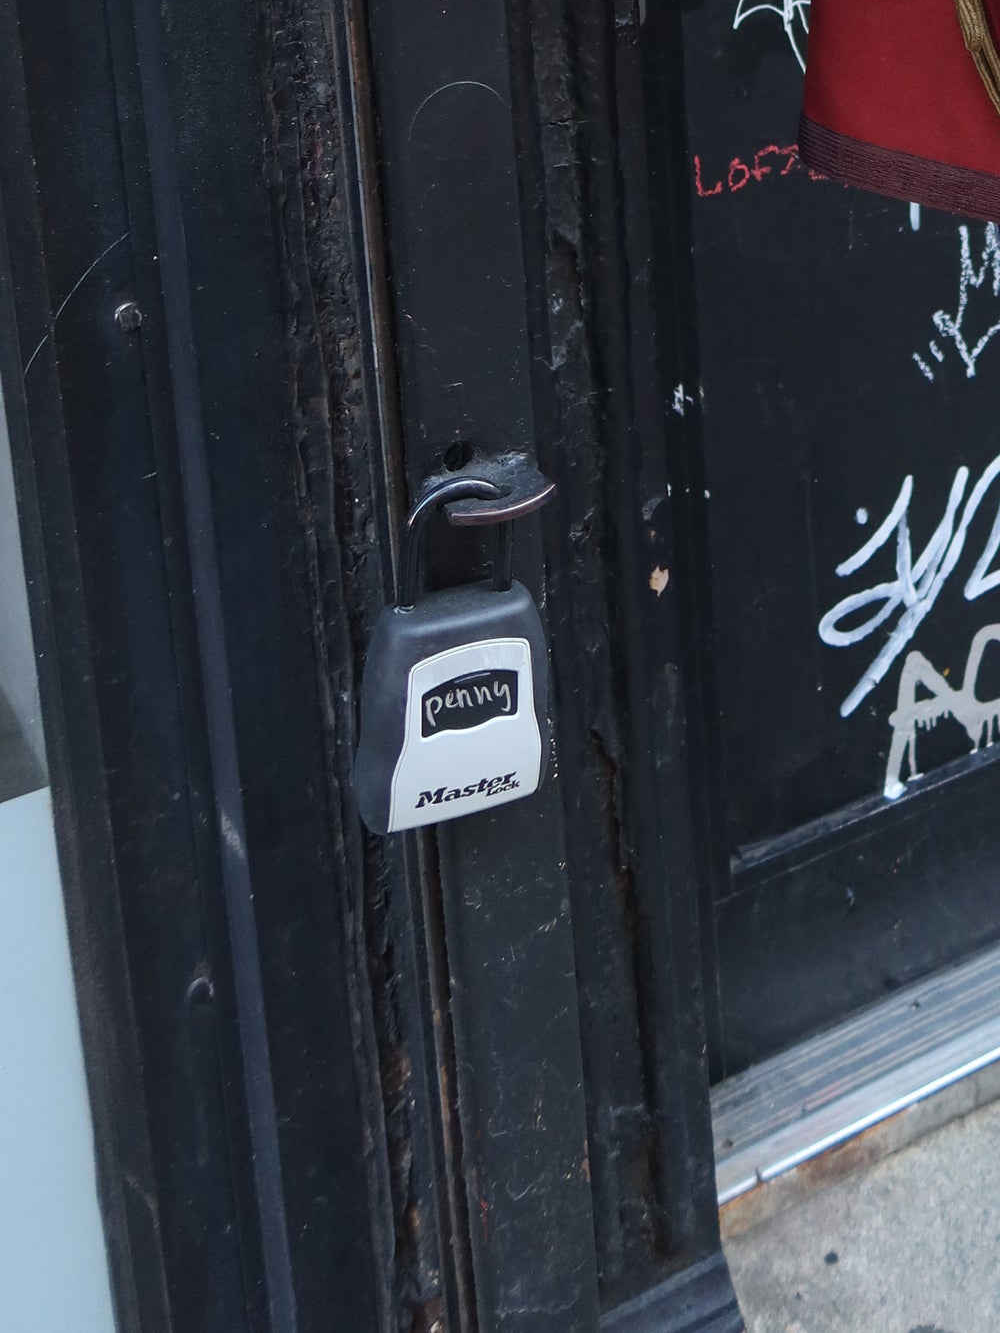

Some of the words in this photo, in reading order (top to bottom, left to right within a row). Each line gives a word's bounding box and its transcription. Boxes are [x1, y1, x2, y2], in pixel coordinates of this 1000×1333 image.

[424, 680, 511, 728] penny
[415, 771, 517, 809] Master
[485, 780, 521, 797] Lock
